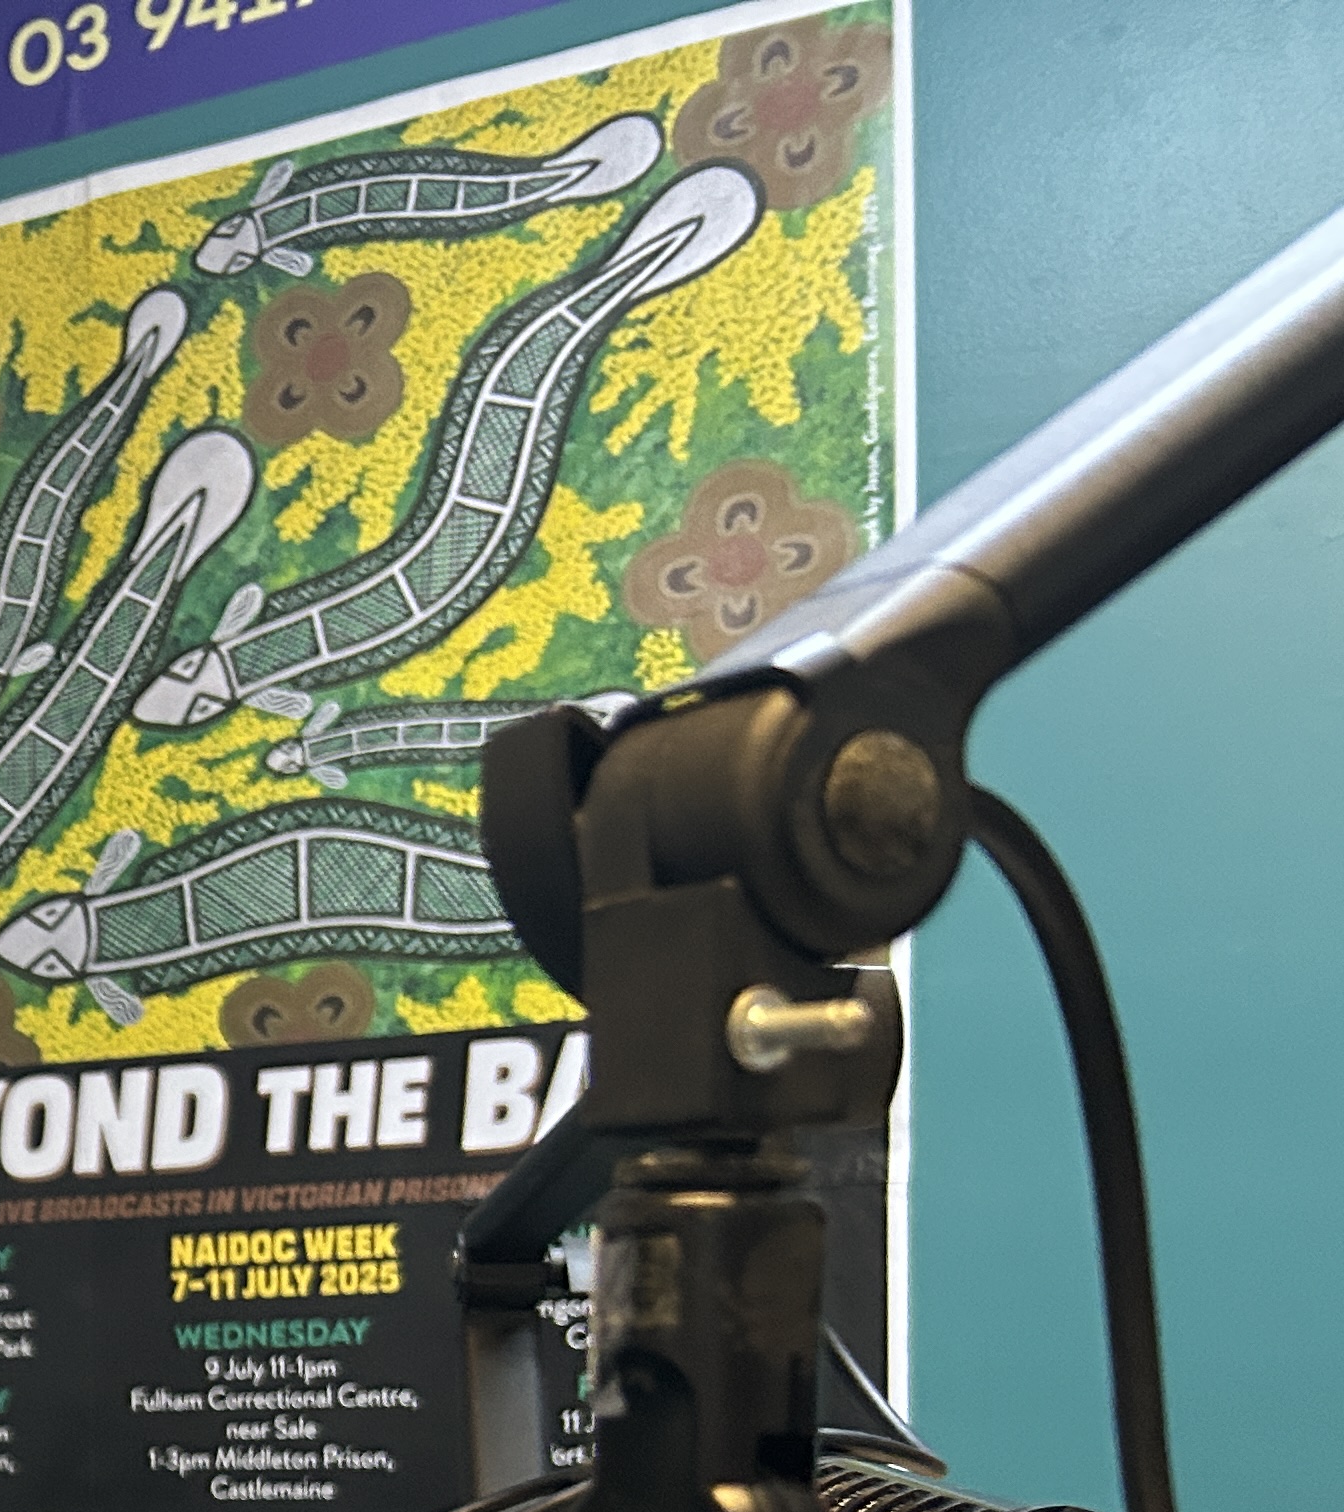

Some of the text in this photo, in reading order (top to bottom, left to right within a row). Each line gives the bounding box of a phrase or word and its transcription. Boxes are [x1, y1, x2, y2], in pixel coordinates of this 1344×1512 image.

[8, 3, 111, 90] 03
[255, 1053, 433, 1155] THE
[39, 1190, 204, 1223] BROADCASTS
[207, 1184, 234, 1215] IN
[240, 1177, 386, 1213] VICTORIAN
[389, 1171, 509, 1204] PRISON
[170, 1222, 401, 1267] NAIDOC WEEK
[171, 1260, 403, 1302] 7-11 JULY 2025
[174, 1317, 372, 1350] WEDNESDAY
[204, 1353, 338, 1387] 9 July 11-1pm
[131, 1381, 420, 1412] Fulham Correctional Centre,
[226, 1413, 320, 1441] near Sale
[148, 1443, 396, 1479] 1-3pm Middleton Prison,
[210, 1474, 335, 1501] Castlemaine
